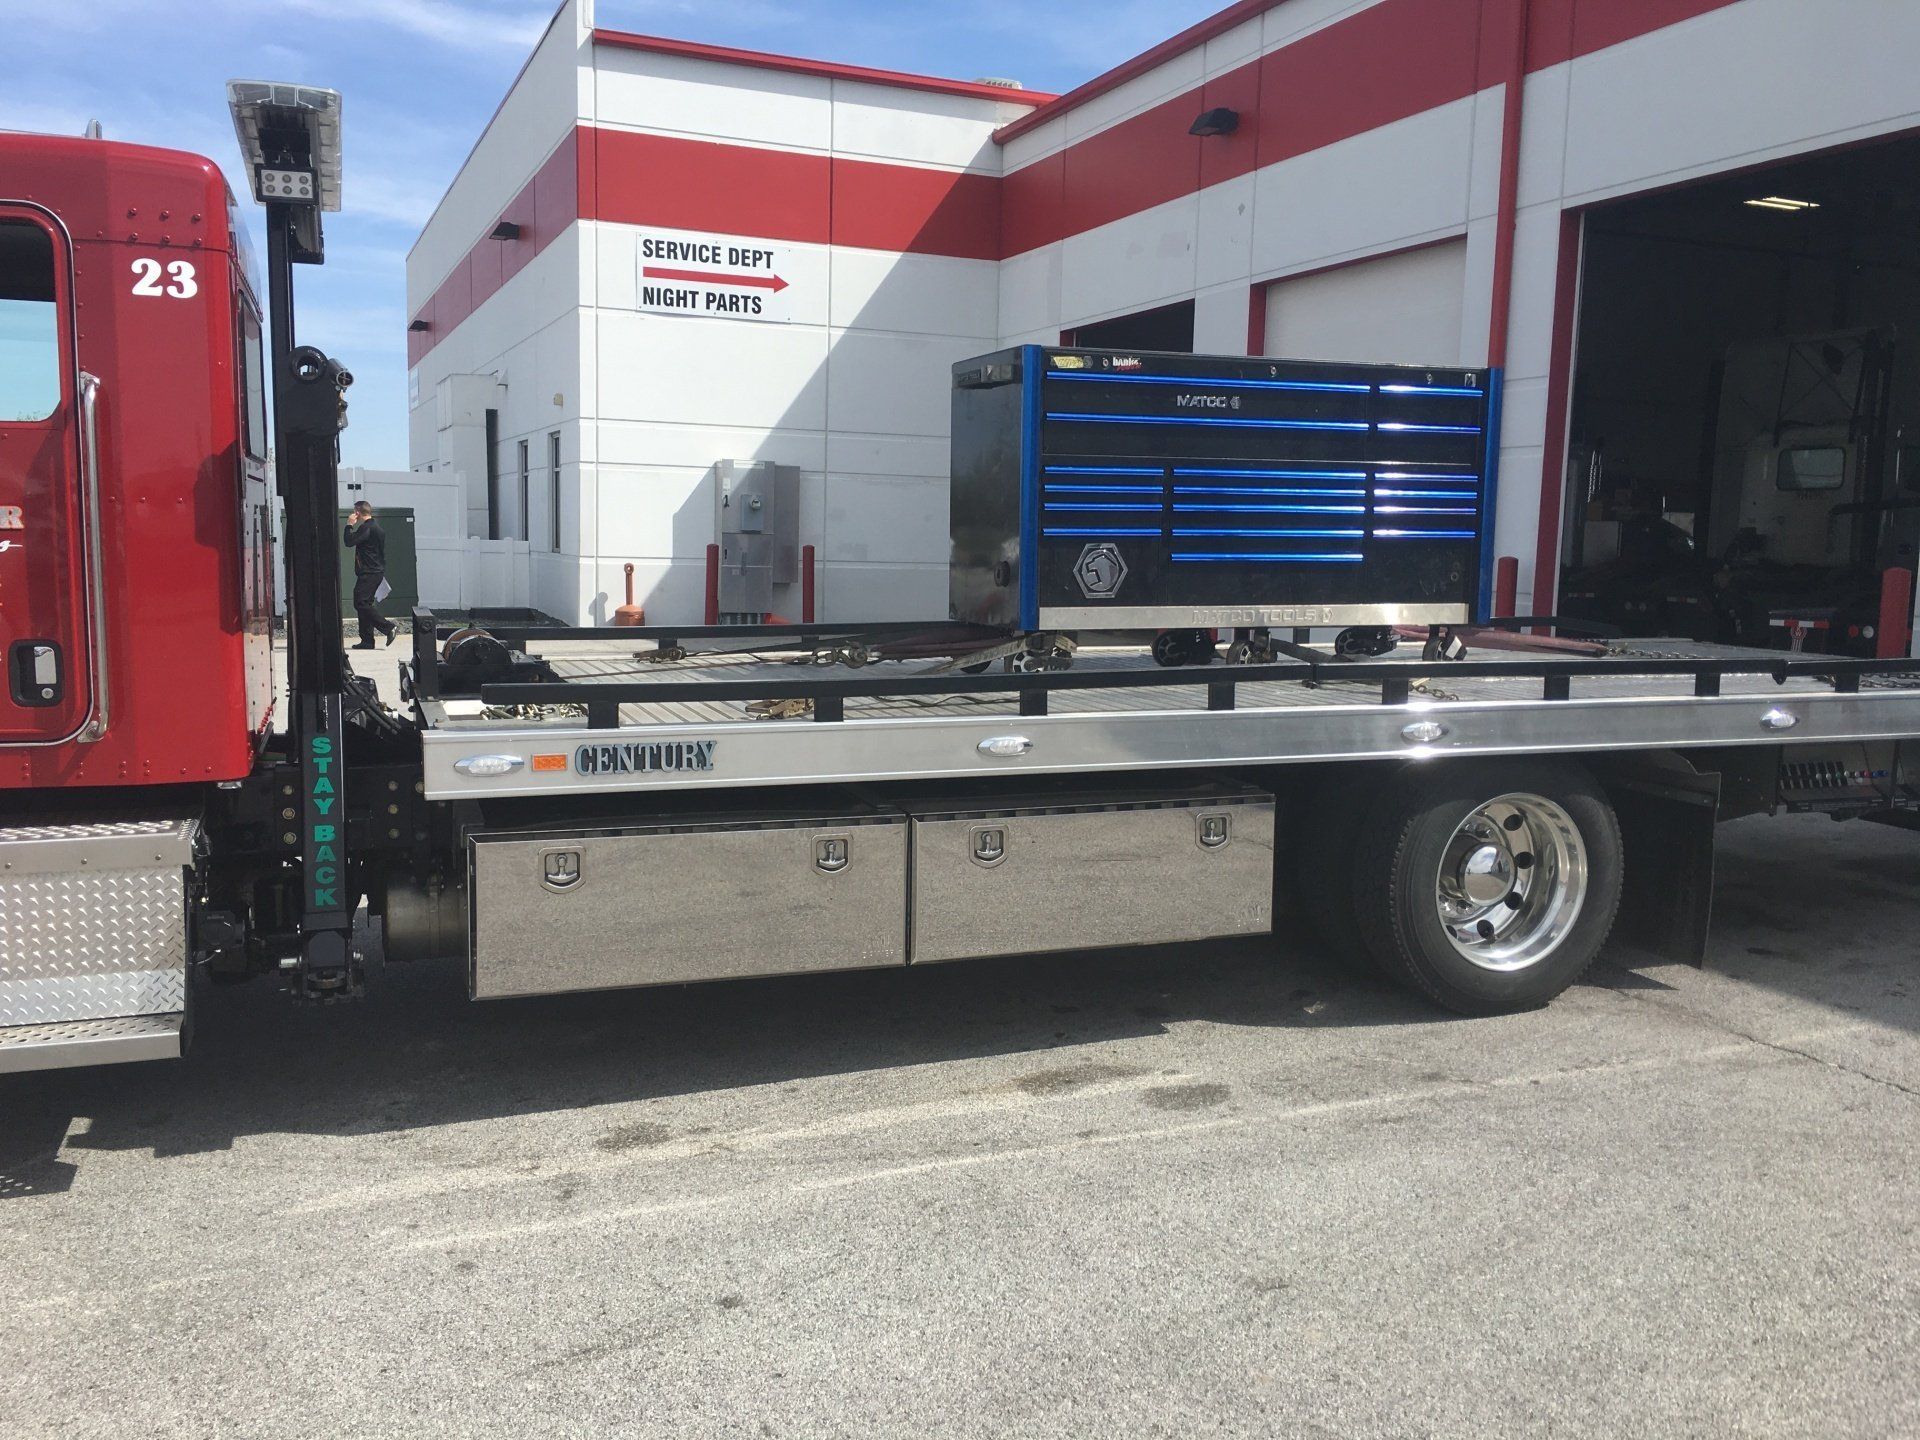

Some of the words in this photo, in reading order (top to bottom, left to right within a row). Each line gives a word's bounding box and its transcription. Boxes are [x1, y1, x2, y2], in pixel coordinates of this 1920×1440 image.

[642, 238, 722, 265] SERVICE
[728, 247, 774, 269] DEPT
[130, 257, 199, 299] 23
[642, 286, 699, 309] NIGHT
[705, 292, 762, 315] PARTS
[1258, 608, 1317, 623] TOOLS
[311, 736, 335, 815] STAY
[574, 740, 718, 777] CENTURY
[313, 825, 338, 907] BACK
